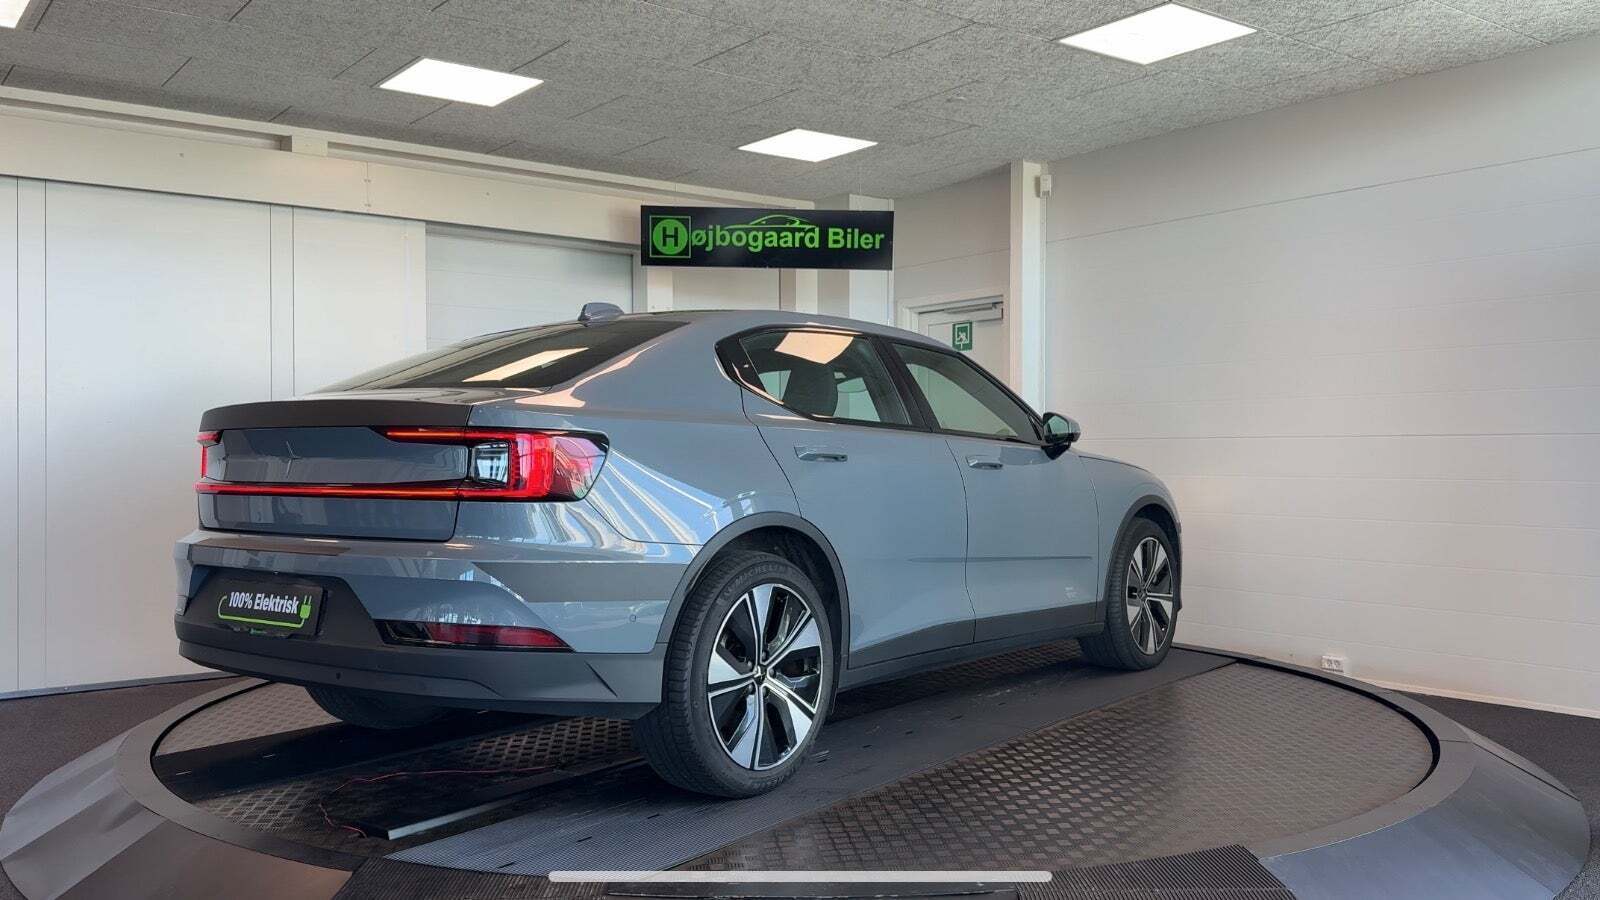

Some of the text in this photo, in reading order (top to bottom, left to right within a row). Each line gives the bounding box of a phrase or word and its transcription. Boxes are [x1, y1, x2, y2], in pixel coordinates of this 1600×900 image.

[828, 228, 885, 249] Biler
[228, 591, 300, 614] 100% Elektrisk
